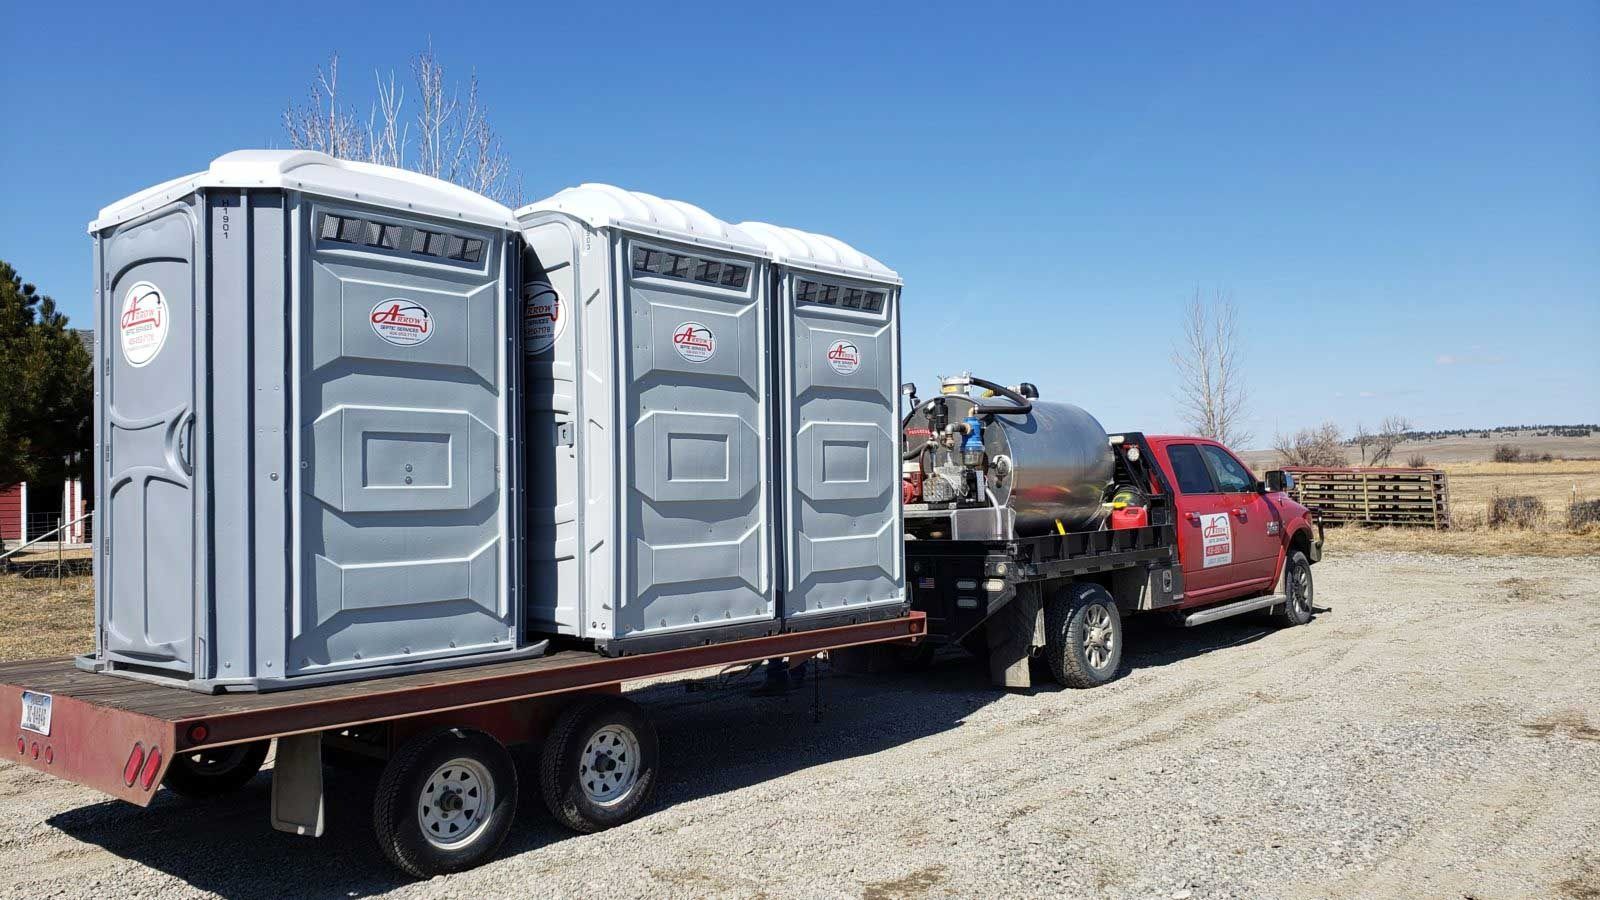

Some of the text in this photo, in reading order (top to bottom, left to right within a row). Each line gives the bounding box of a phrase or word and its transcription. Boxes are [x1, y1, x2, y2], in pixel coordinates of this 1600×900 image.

[222, 199, 230, 240] H1901
[121, 295, 154, 330] ARROW
[371, 304, 420, 324] ARROW
[674, 326, 708, 344] ARROW
[1204, 517, 1226, 538] ARROW
